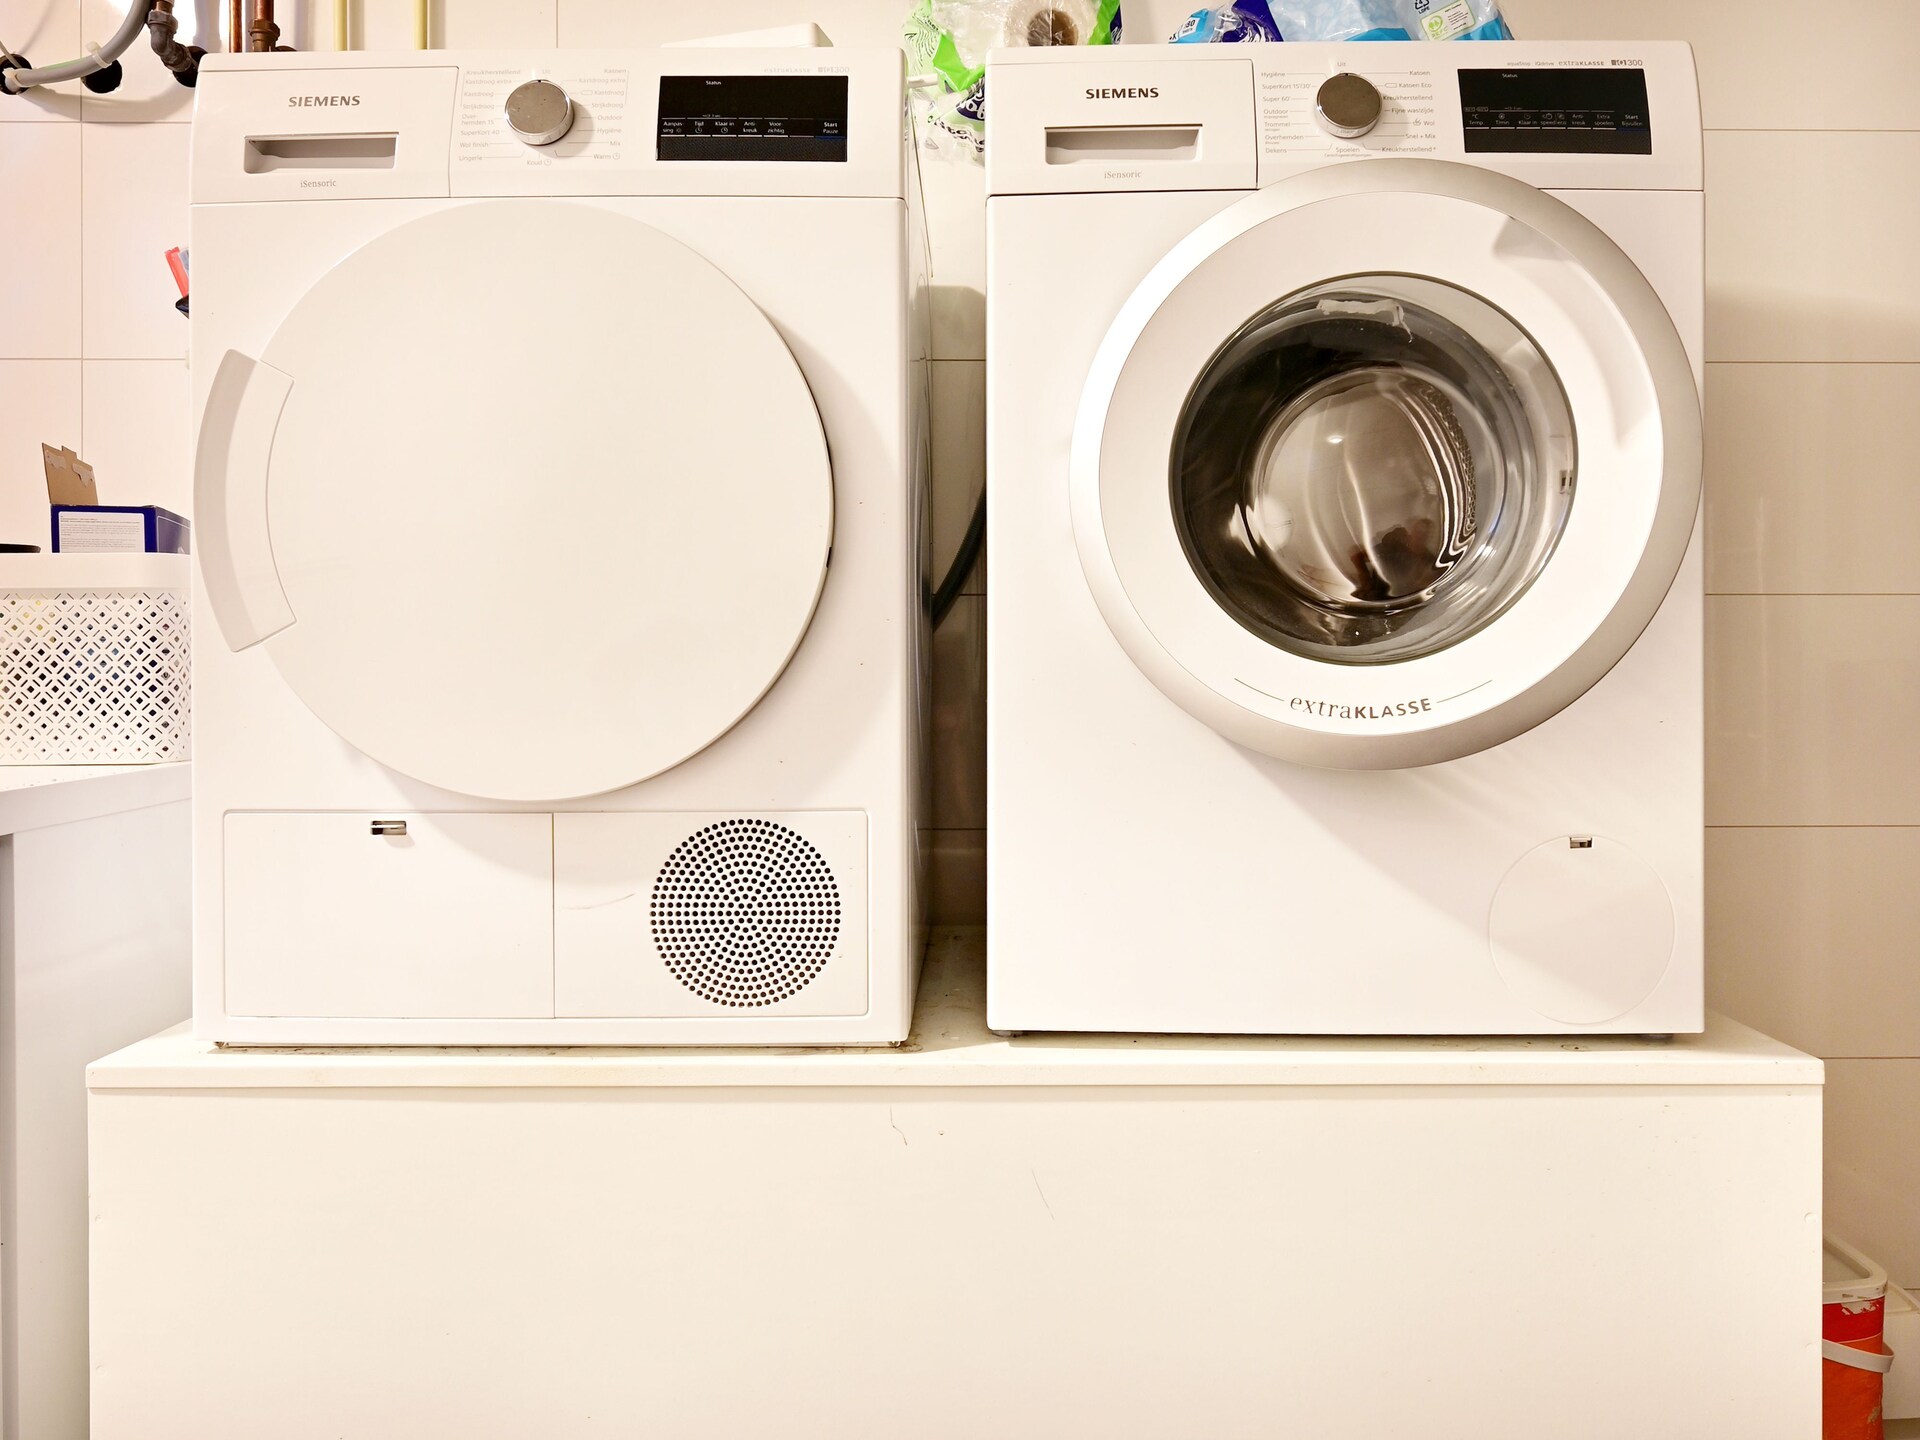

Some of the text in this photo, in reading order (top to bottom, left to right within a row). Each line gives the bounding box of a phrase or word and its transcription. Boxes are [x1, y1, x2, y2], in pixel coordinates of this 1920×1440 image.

[1086, 88, 1159, 99] SIEMENS
[288, 95, 361, 107] SIEMENS
[1104, 171, 1142, 179] iSensoric
[300, 179, 337, 188] iSensoric
[1290, 697, 1432, 719] extraKLASSE
